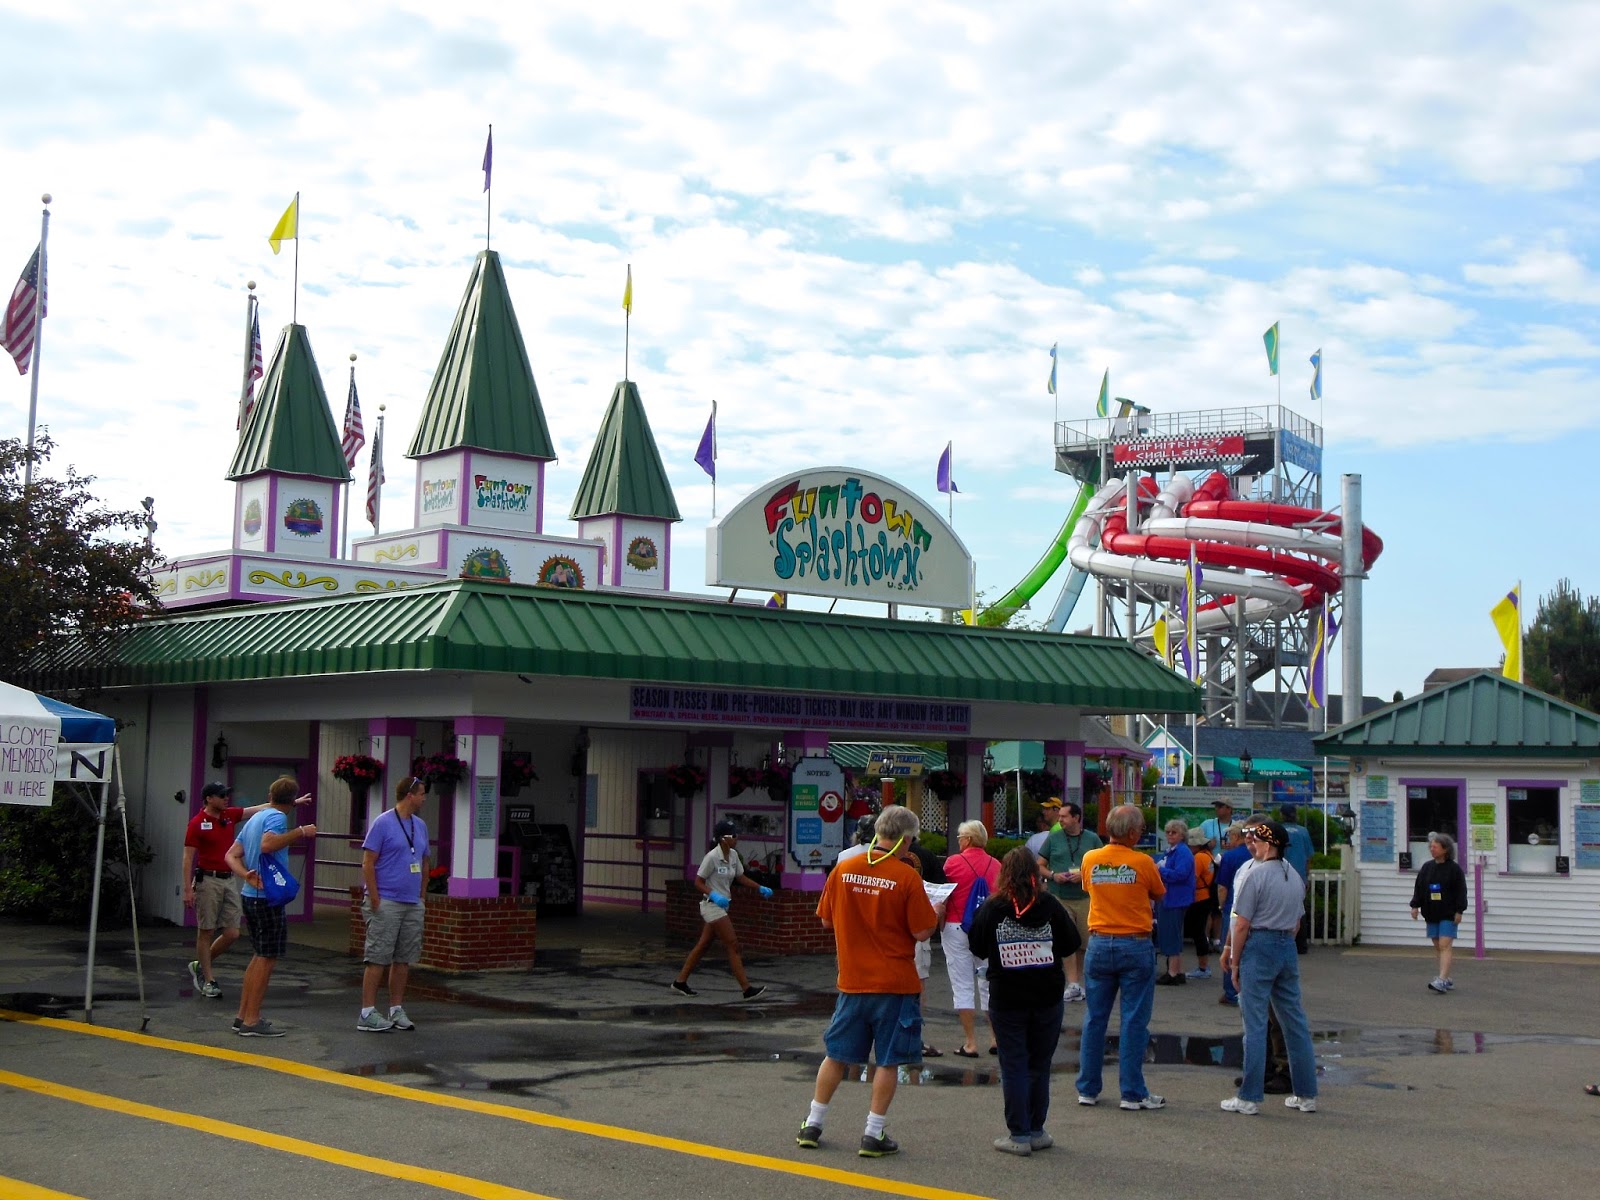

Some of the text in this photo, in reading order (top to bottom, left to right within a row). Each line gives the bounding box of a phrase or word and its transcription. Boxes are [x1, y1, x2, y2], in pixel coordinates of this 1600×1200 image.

[1128, 438, 1224, 452] AMPHITRITE'S
[1136, 447, 1217, 459] CHALLENGE
[633, 688, 969, 722] SEASON PASSES AND PRE-PURCHASED TICKETS MAY USE ANY WINDOW FOR ENTRY
[2, 747, 55, 775] MEMBERS
[4, 781, 13, 795] IN
[19, 781, 46, 797] HERE
[842, 873, 896, 890] TIMBERSFEST
